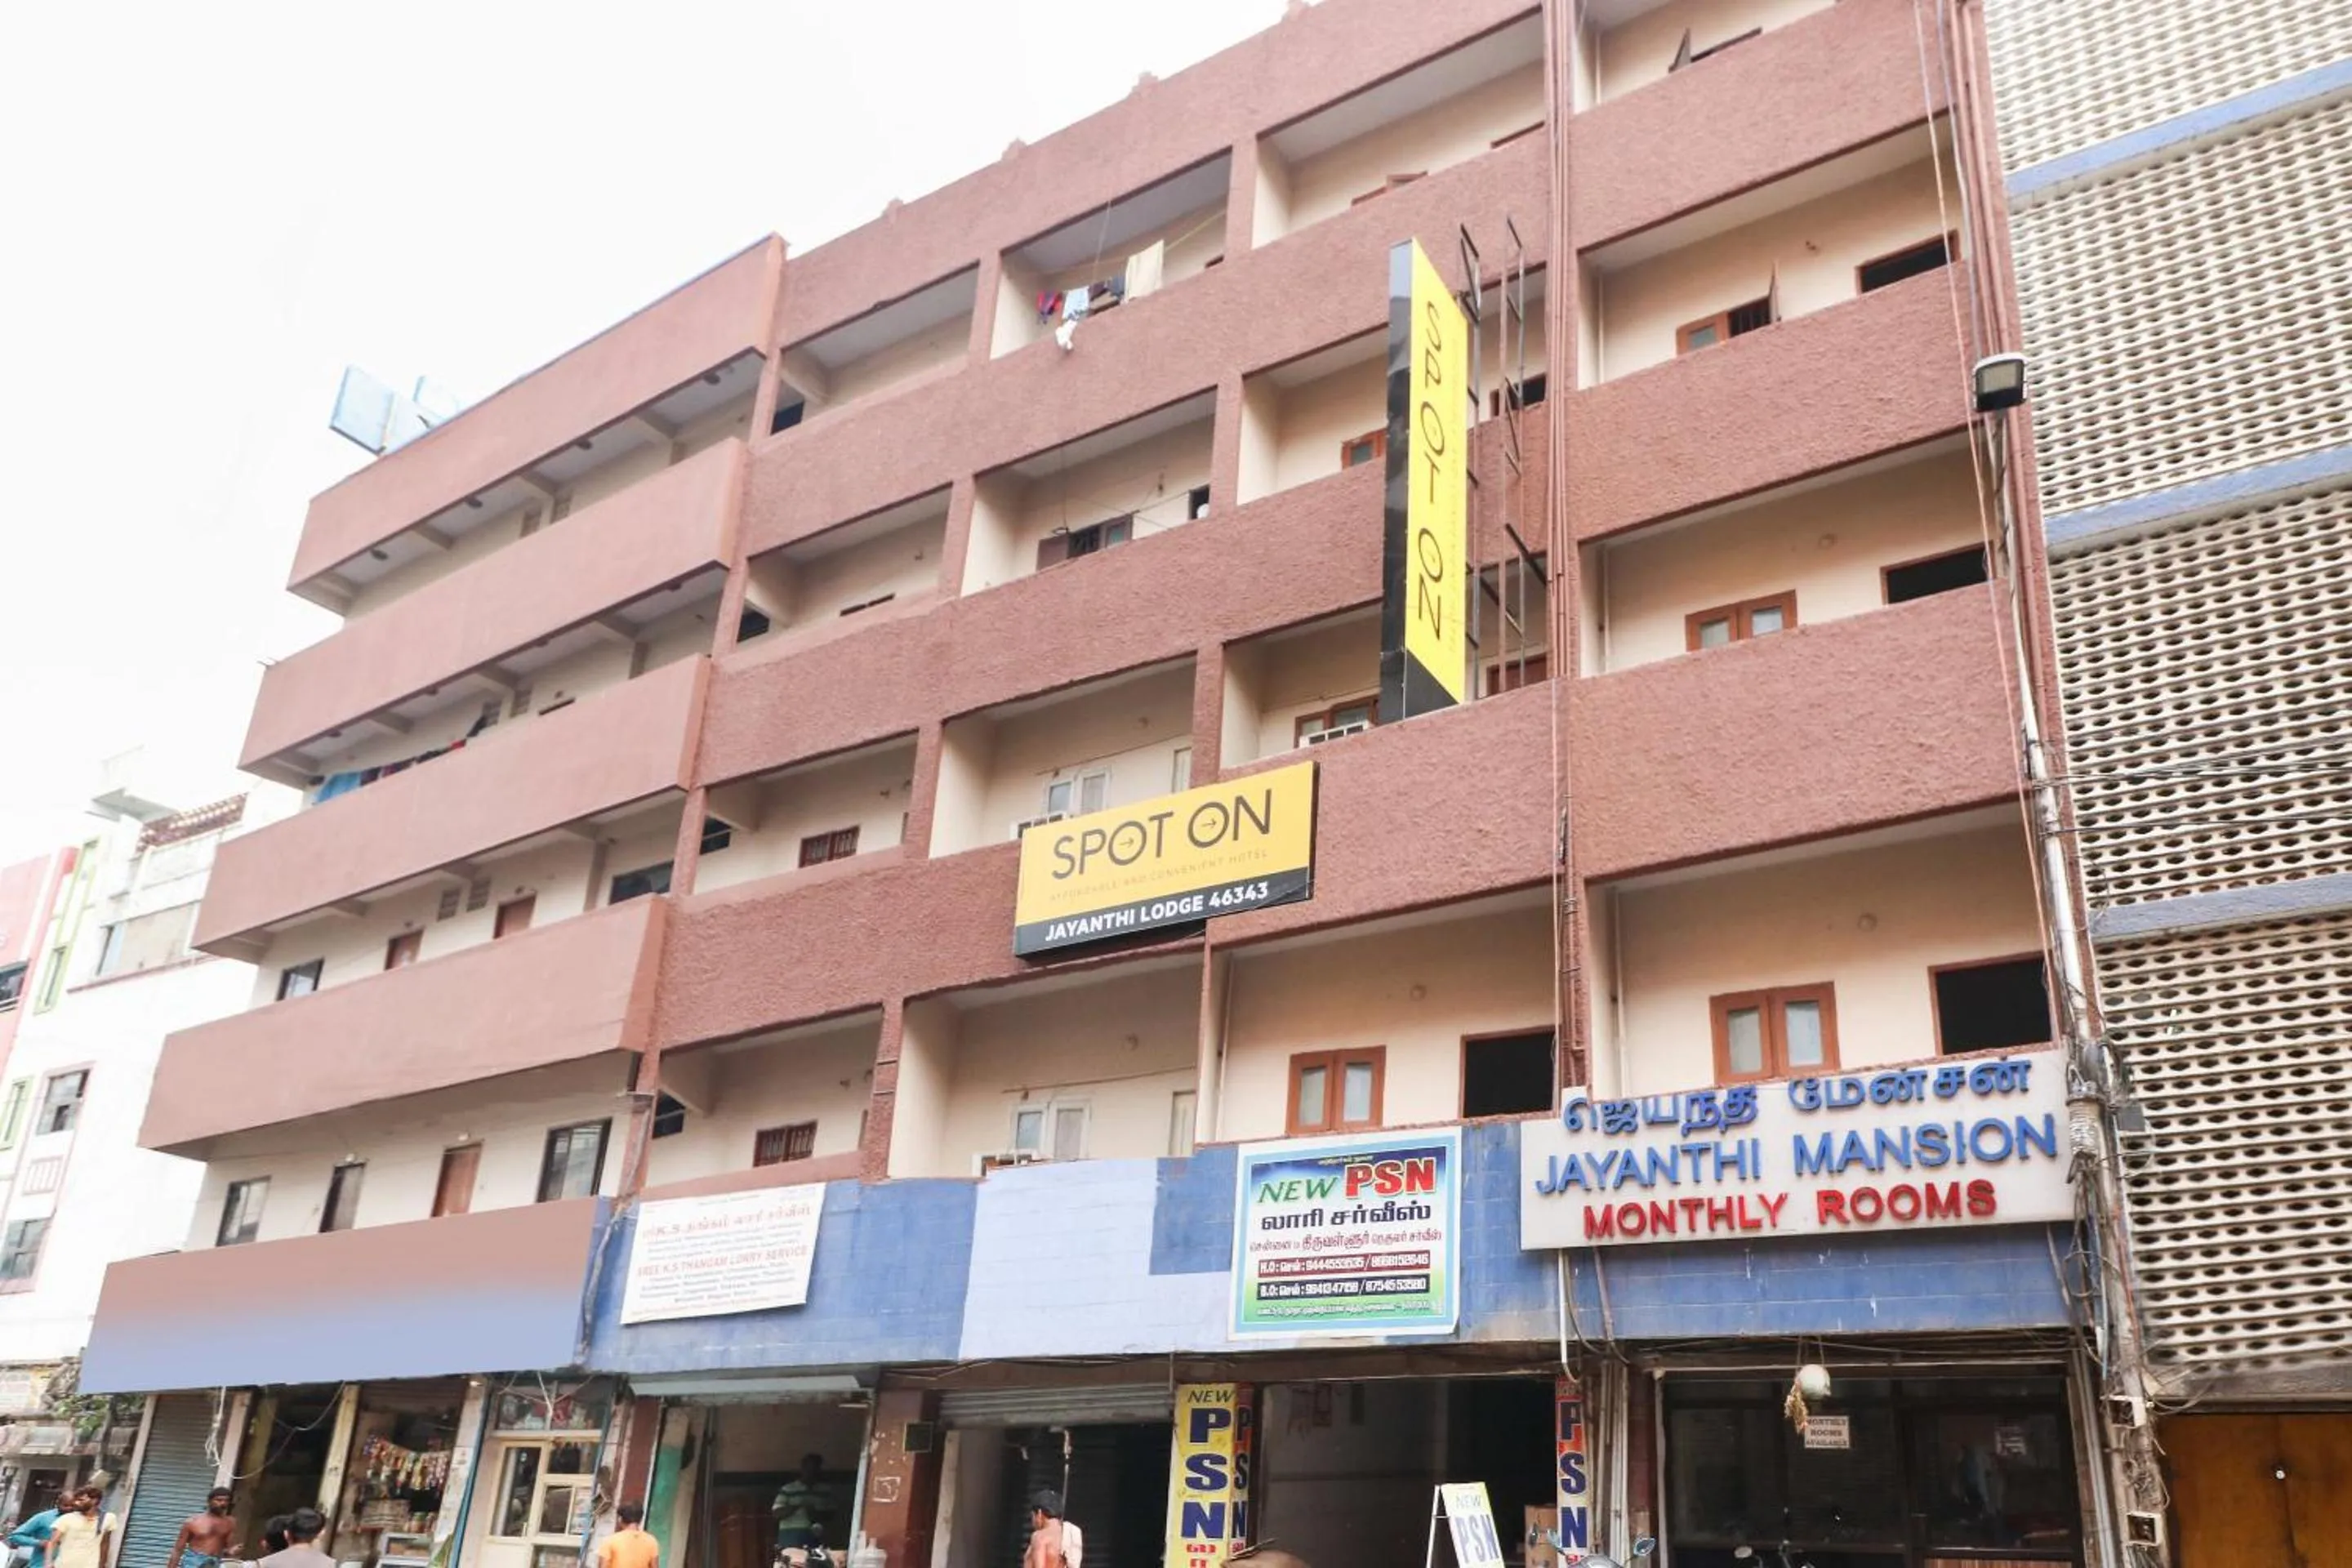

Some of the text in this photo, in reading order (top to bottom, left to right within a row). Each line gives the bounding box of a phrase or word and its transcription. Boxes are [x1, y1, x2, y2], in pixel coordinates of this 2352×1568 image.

[1419, 301, 1445, 642] SPOT ON
[1052, 788, 1272, 880] SPOT ON
[1045, 881, 1268, 942] JAYANTHI LODGE 46343
[1258, 1157, 1437, 1203] NEW PSN
[1536, 1113, 2058, 1194] JAYANTHI MANSION
[1584, 1178, 1997, 1240] MONTHLY ROOMS
[1187, 1390, 1233, 1403] NEW
[1181, 1408, 1232, 1539] PSN
[1232, 1407, 1252, 1539] PSN
[1560, 1401, 1588, 1548] PSN
[1454, 1514, 1499, 1564] PSN
